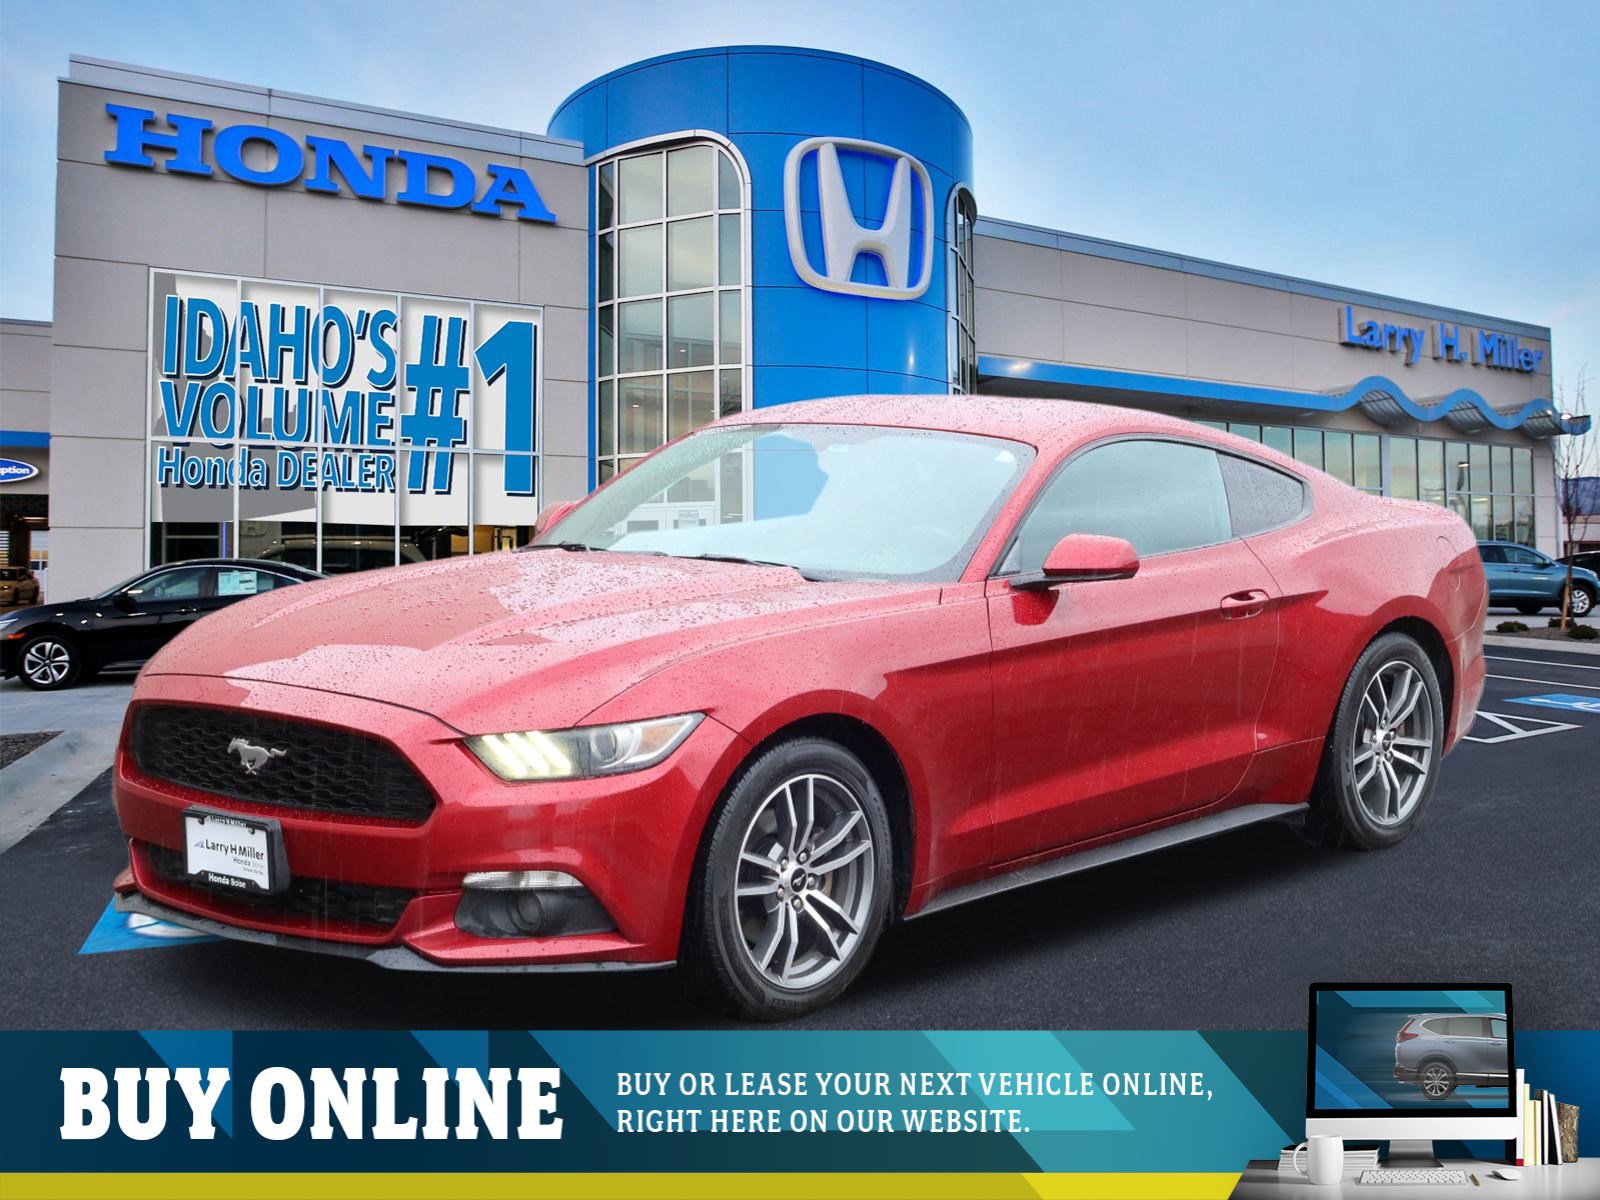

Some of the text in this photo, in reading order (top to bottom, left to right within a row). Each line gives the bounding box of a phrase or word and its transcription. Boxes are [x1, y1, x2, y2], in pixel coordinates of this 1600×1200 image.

[103, 103, 557, 224] HONDA
[161, 294, 398, 389] IDAHO'S
[1341, 305, 1545, 372] Larry H. Miller
[159, 380, 396, 448] VOLUME
[401, 314, 537, 495] #1
[0, 466, 29, 476] ption
[157, 446, 396, 493] Honda DEALER
[205, 839, 264, 860] Larry H Miller
[208, 872, 246, 888] Honda Boise
